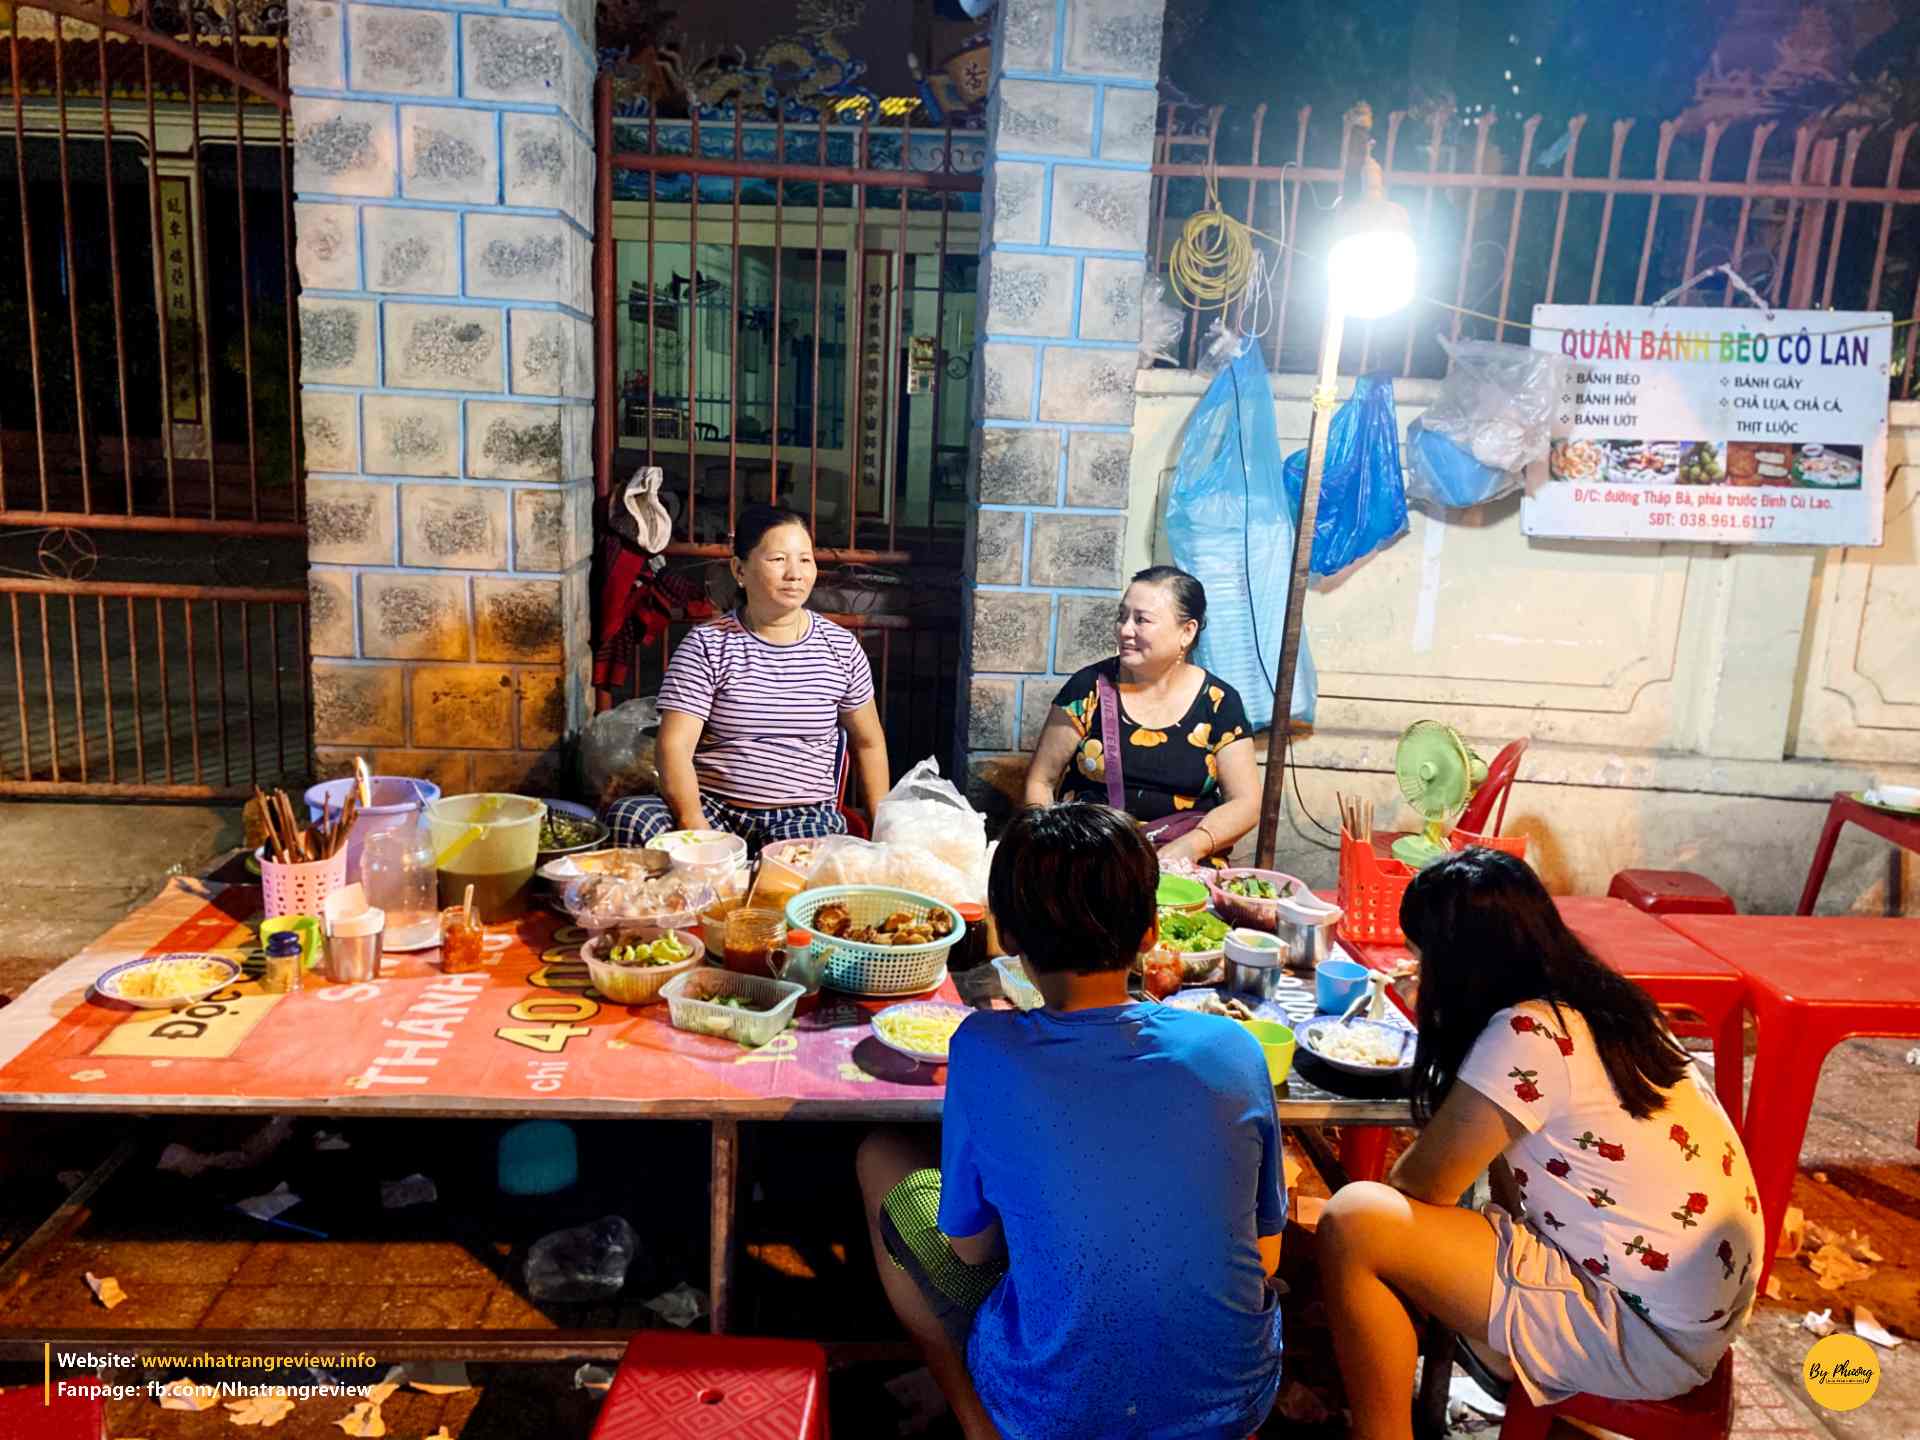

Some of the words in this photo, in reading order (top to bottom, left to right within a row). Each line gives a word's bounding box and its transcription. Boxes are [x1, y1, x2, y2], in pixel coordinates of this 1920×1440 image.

[1561, 322, 1632, 361] QUÁN
[1640, 324, 1711, 362] BÁNH
[1719, 325, 1769, 364] BÈO
[1778, 326, 1812, 365] CÔ
[1820, 334, 1869, 367] LAN
[1648, 512, 1676, 527] SĐT:
[1680, 513, 1776, 529] 038.961.6117
[353, 972, 491, 1089] THÁNH
